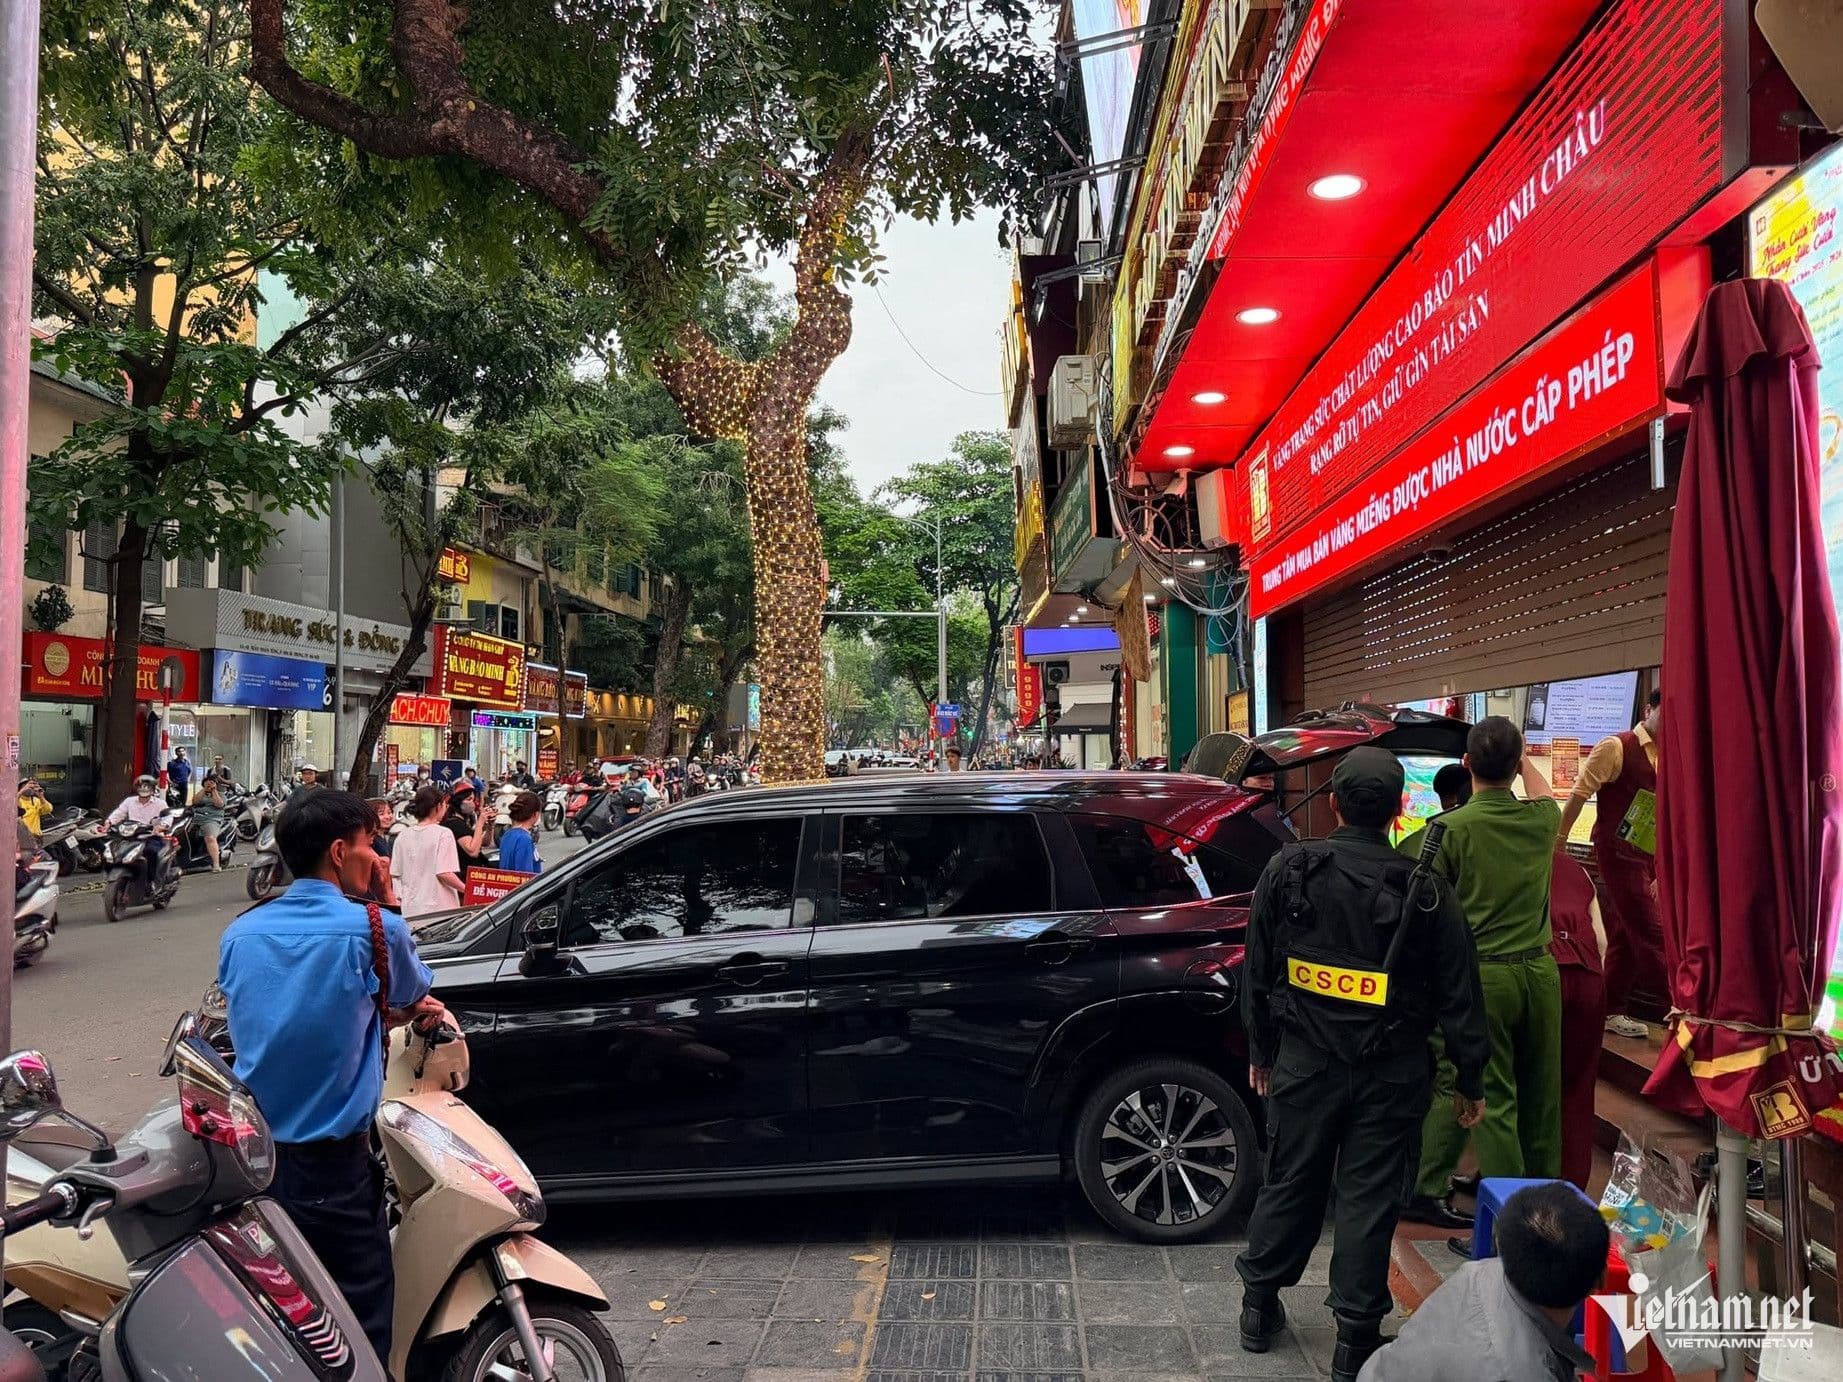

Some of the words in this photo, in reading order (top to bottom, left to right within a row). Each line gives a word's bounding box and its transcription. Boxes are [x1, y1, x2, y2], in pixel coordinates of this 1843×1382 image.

[1290, 414, 1315, 452] TRANG
[1314, 397, 1332, 431] SỨC
[1331, 369, 1356, 413] CHẤT
[1356, 330, 1394, 389] LƯỢNG
[1394, 302, 1423, 347] CAO
[1423, 267, 1453, 320] BẢO
[1455, 235, 1483, 286] TÍN
[1486, 177, 1537, 256] MINH
[1540, 97, 1606, 196] CHÂU
[1310, 440, 1333, 476] RẠNG
[1332, 420, 1347, 452] RỠ
[1345, 407, 1361, 443] TỰ
[1360, 394, 1383, 430] TIN,
[1382, 364, 1405, 410] GIỮ
[1405, 346, 1430, 389] GÌN
[1430, 321, 1456, 365] TÀI
[1458, 288, 1489, 342] SẢN
[1262, 563, 1283, 593] TRUNG
[1281, 552, 1296, 582] TÂM
[1296, 544, 1313, 573] MUA
[1312, 529, 1330, 563] BÁN
[1330, 517, 1355, 553] VÀNG
[1356, 493, 1391, 538] MIẾNG
[1392, 464, 1430, 515] ĐƯỢC
[1432, 435, 1464, 492] NHÀ
[1466, 406, 1518, 471] NƯỚC
[1521, 373, 1562, 437] CẤP
[1567, 328, 1635, 410] PHÉP
[241, 608, 303, 637] TRANG
[473, 882, 486, 897] ĐỀ
[1295, 965, 1377, 996] CSCĐ
